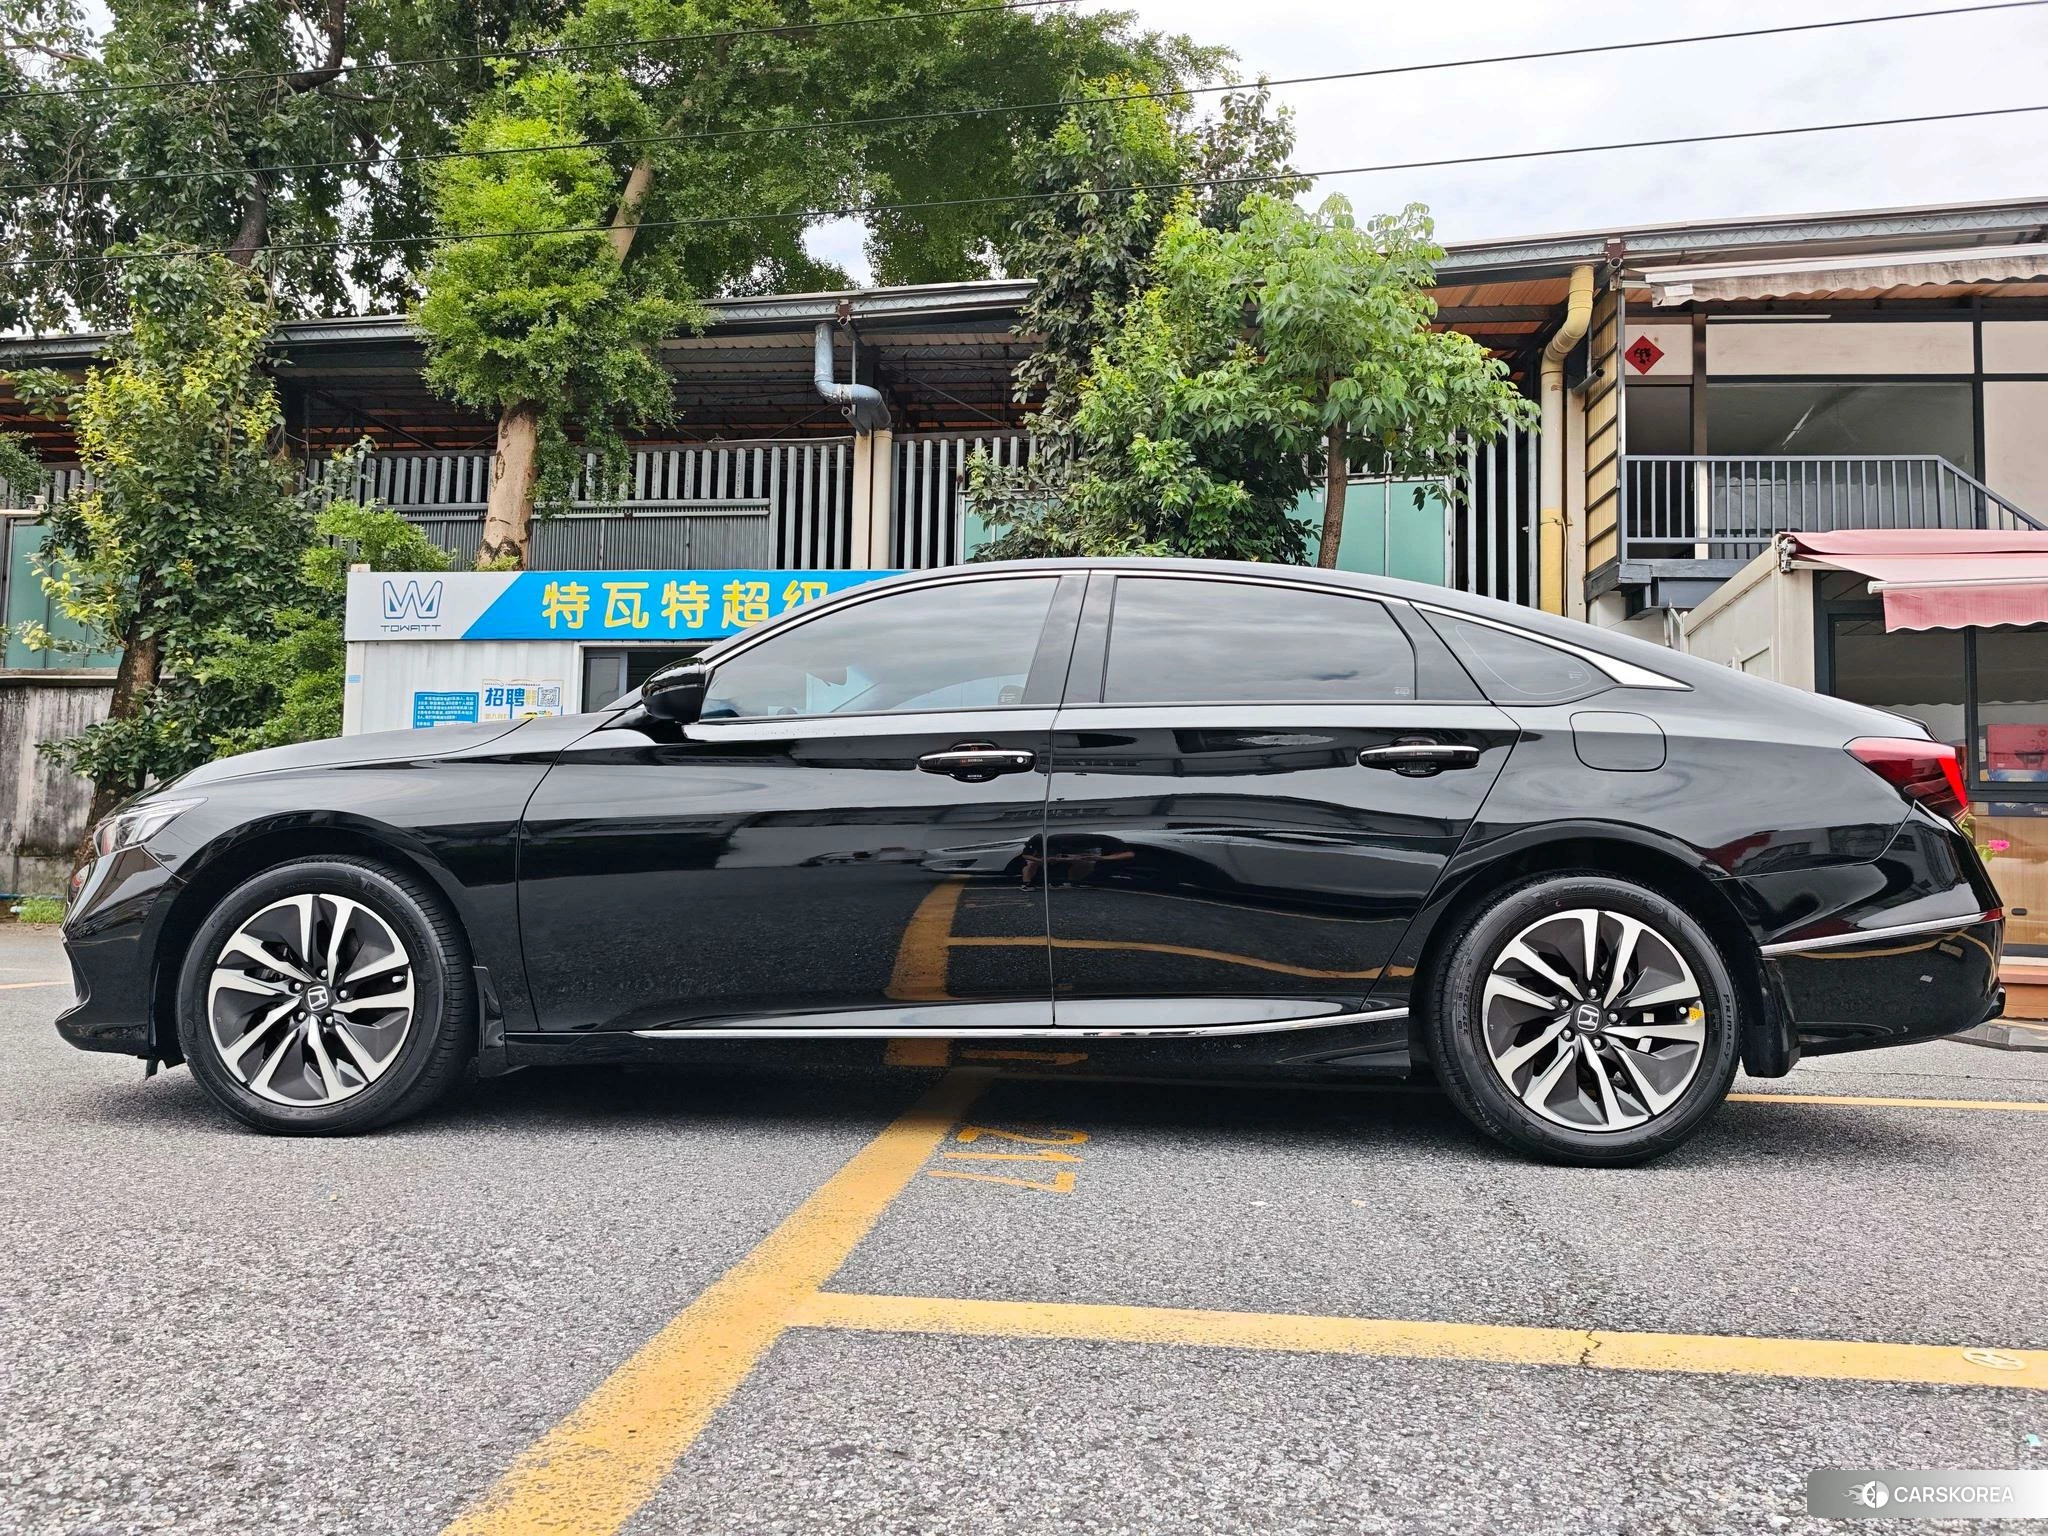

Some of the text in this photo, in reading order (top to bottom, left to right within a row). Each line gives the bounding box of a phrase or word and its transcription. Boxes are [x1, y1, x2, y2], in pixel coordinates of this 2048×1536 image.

[380, 624, 441, 632] TOWATT
[485, 687, 525, 707] 招聘
[928, 1125, 1091, 1193] 217
